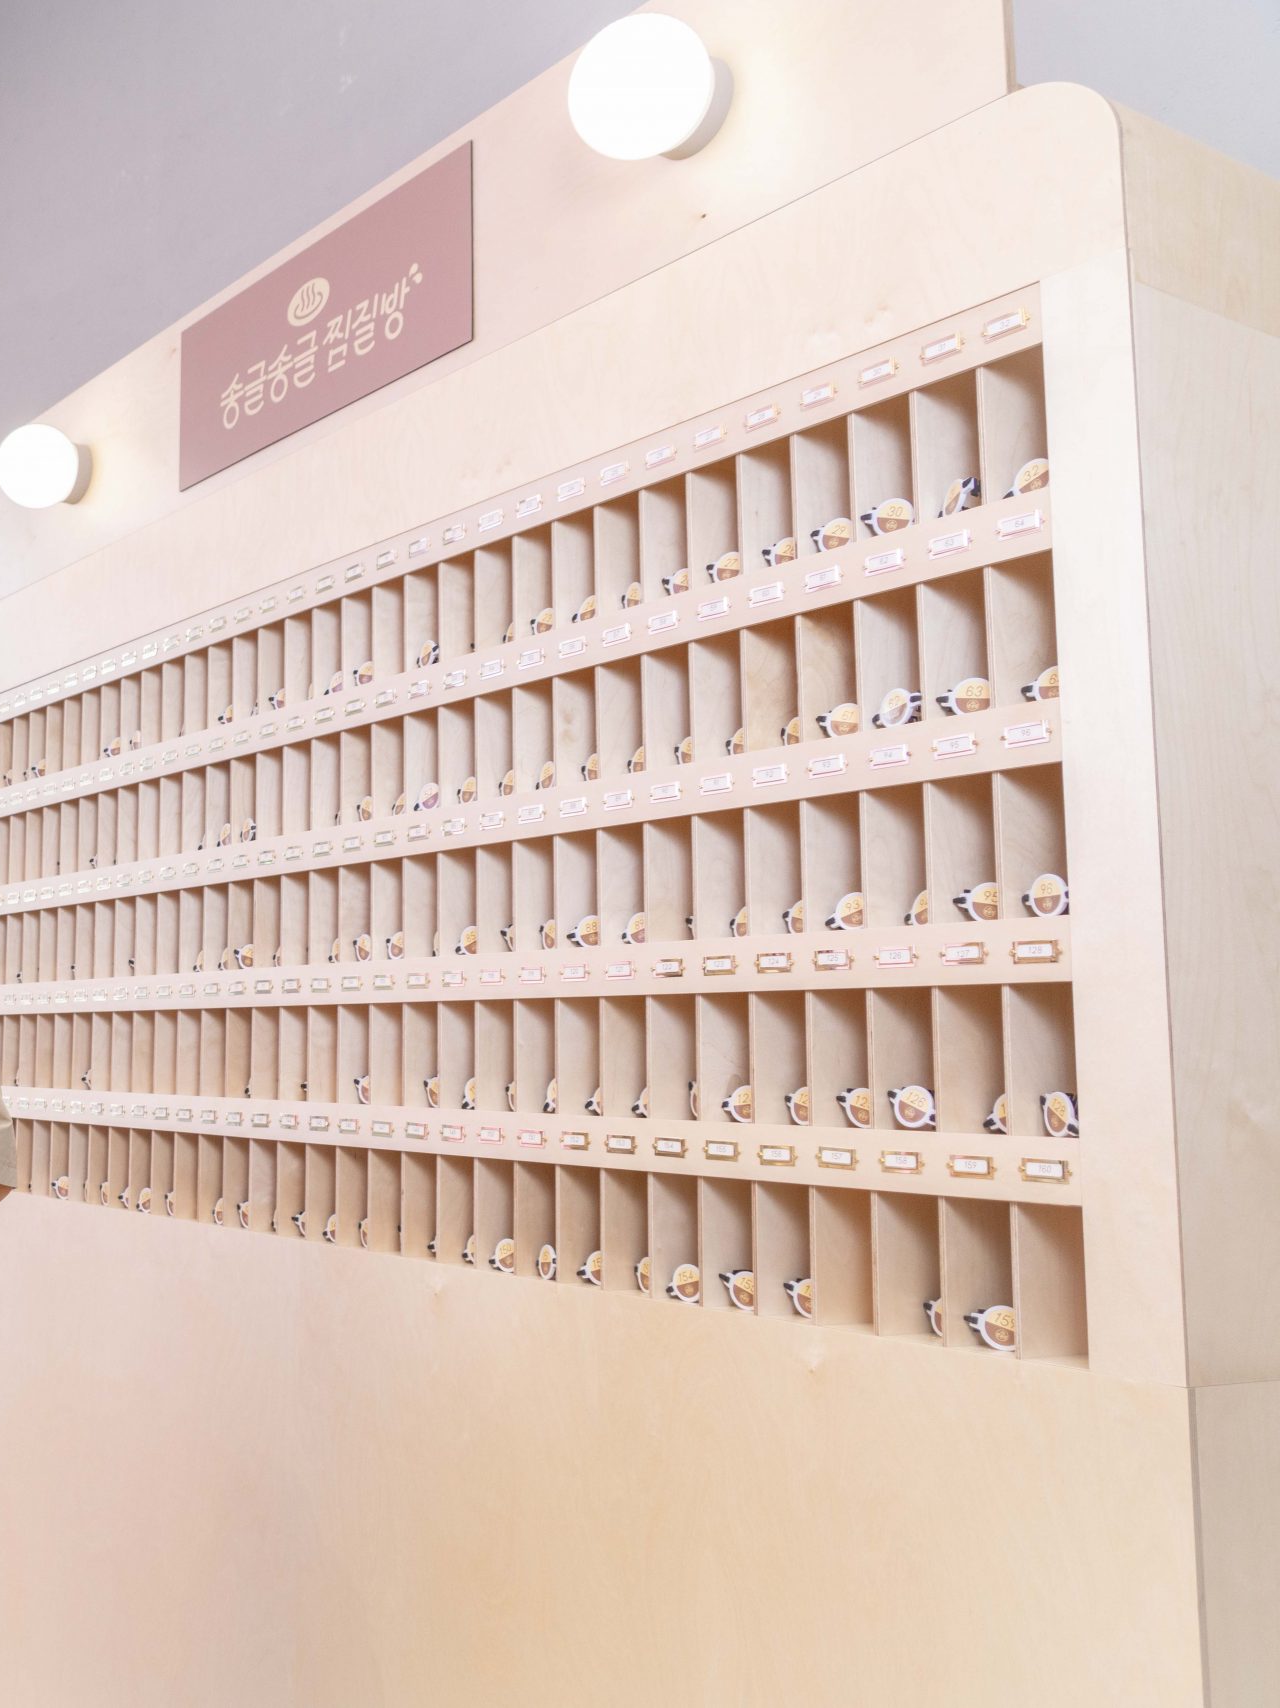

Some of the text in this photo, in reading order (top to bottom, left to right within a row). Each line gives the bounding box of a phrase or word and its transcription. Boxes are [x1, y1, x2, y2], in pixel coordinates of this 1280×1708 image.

[221, 277, 411, 429] 송글송글 찜질방
[1023, 465, 1039, 482] 32
[887, 506, 903, 517] 30
[832, 524, 846, 535] 29
[724, 558, 738, 567] 27
[965, 685, 983, 697] 63
[1040, 883, 1053, 895] 96
[845, 899, 861, 912] 93
[585, 921, 598, 933] 88
[956, 950, 969, 958] 127
[908, 1091, 925, 1107] 126
[964, 1161, 977, 1170] 159
[678, 1270, 694, 1283] 154
[740, 1277, 754, 1291] 15
